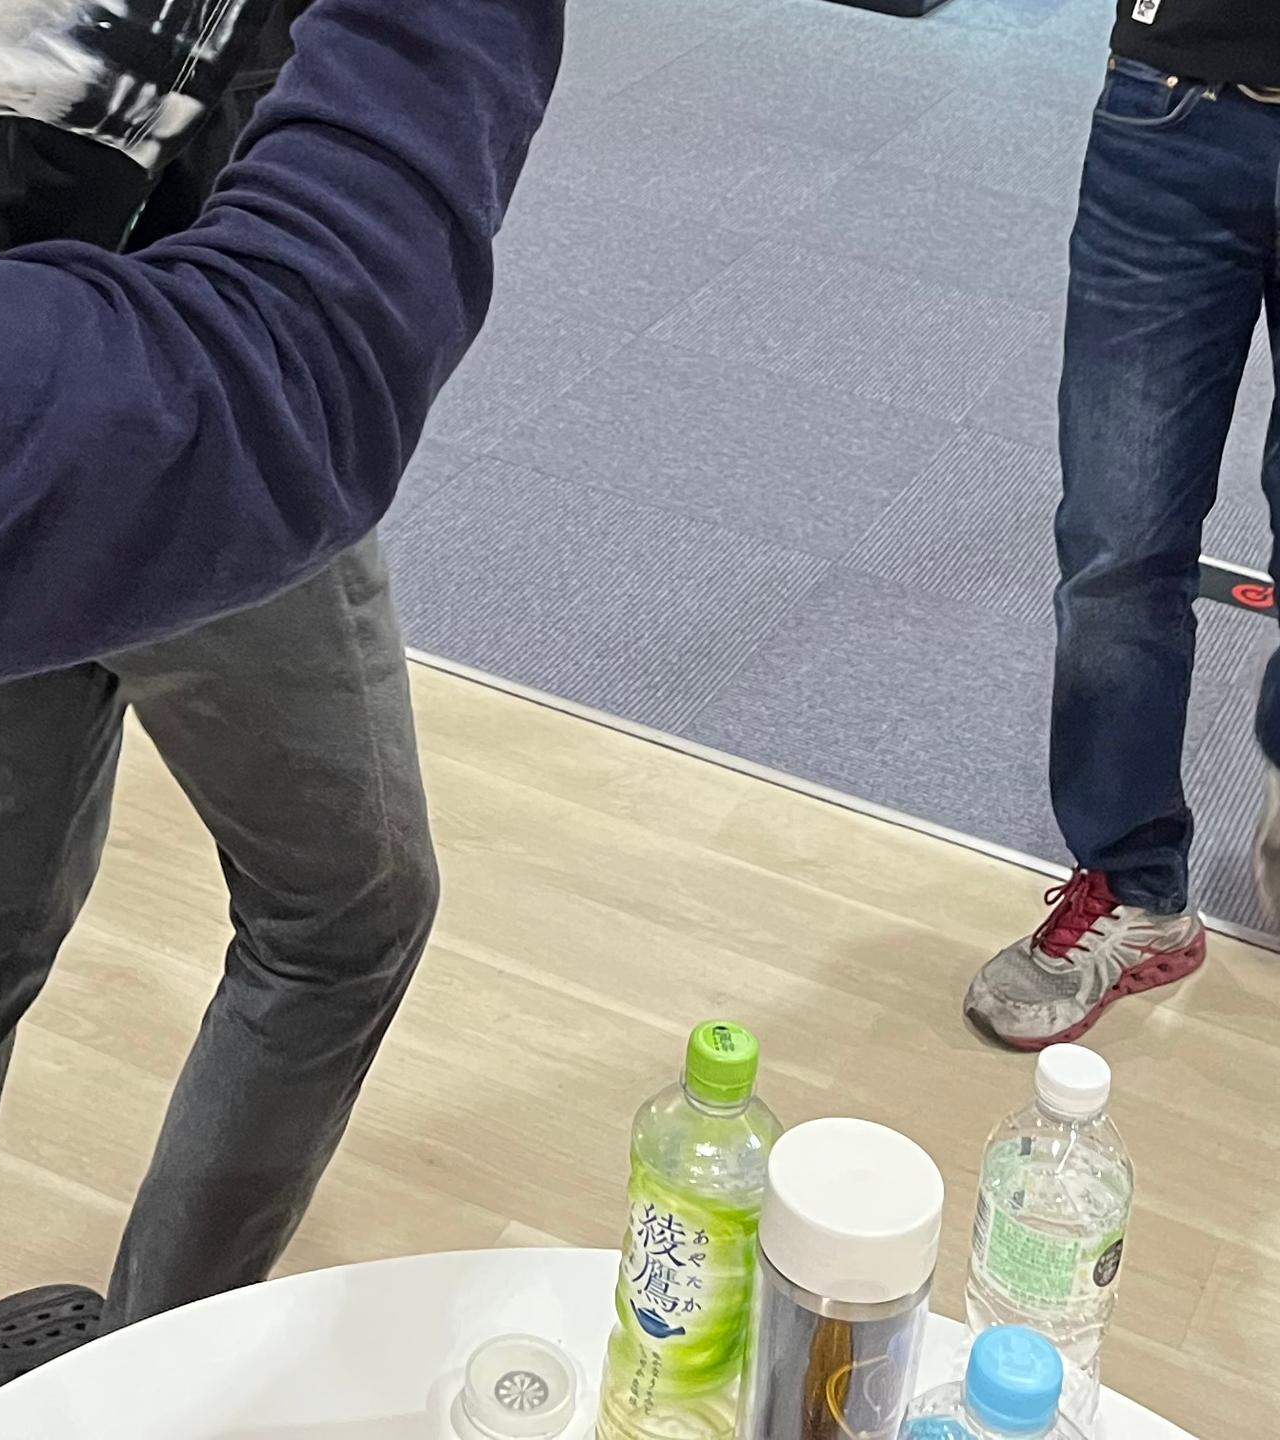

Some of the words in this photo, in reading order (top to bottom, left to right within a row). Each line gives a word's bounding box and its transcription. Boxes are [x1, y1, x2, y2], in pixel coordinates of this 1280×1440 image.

[631, 1202, 687, 1314] 綾鷹
[682, 1228, 711, 1314] あやたか
